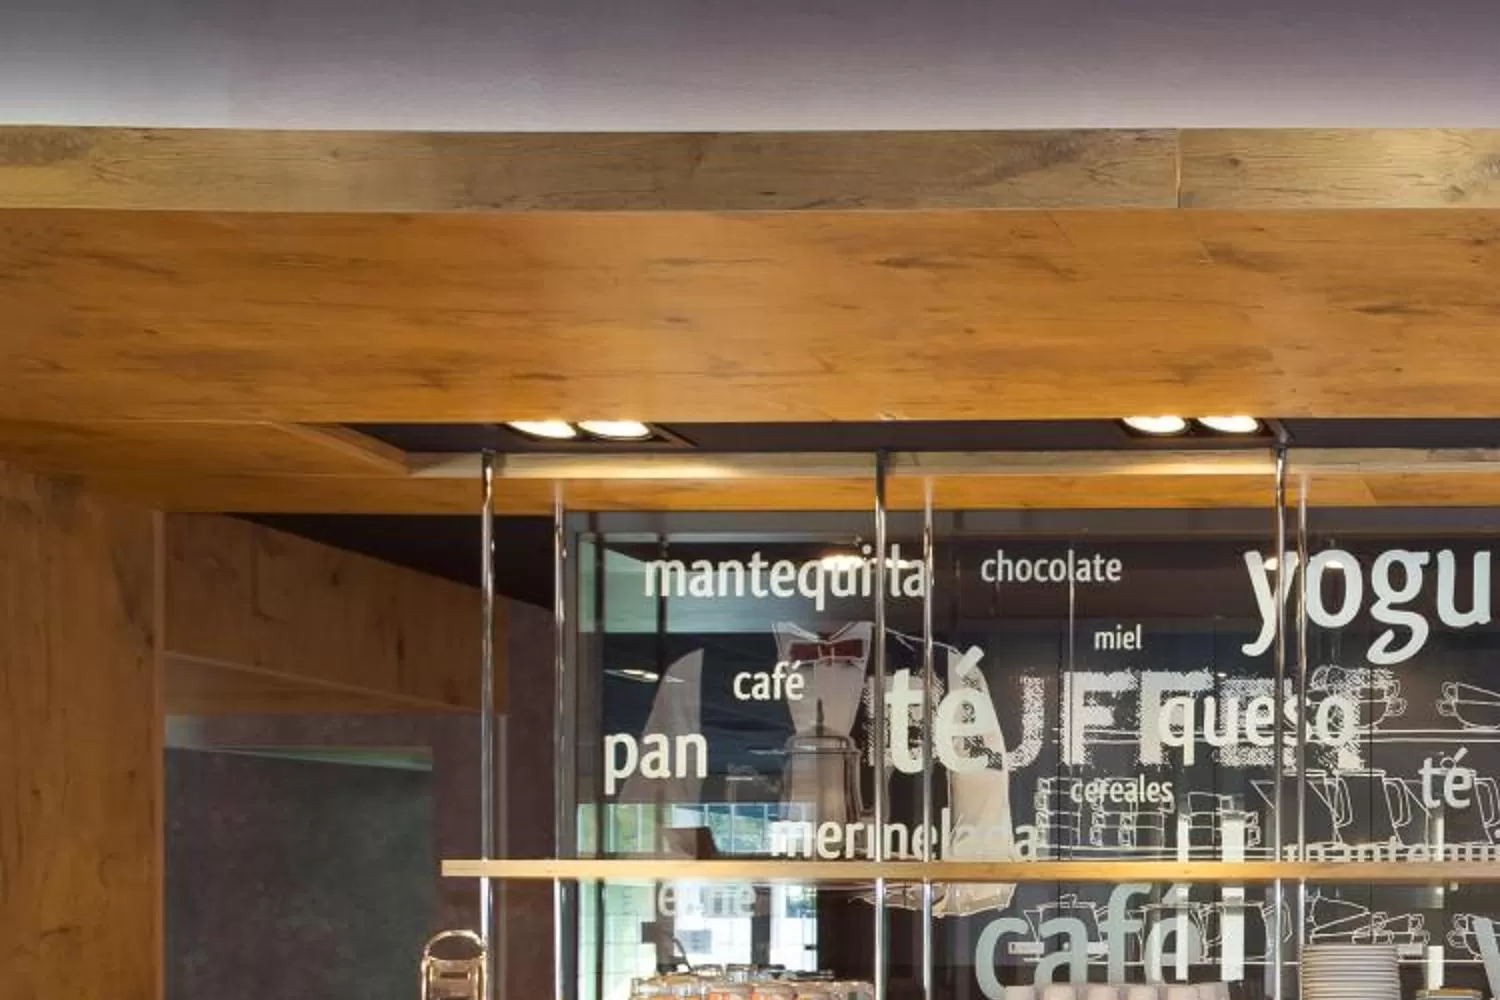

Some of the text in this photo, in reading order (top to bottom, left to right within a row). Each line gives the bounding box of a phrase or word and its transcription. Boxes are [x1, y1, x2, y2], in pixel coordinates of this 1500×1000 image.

[644, 543, 929, 611] mantequila
[980, 549, 1122, 583] chocolate
[1094, 623, 1143, 650] miel
[732, 661, 805, 701] café
[884, 645, 996, 773] té
[1157, 694, 1351, 766] queso
[604, 732, 708, 795] pan
[1069, 773, 1174, 804] cereales
[1419, 747, 1473, 809] té
